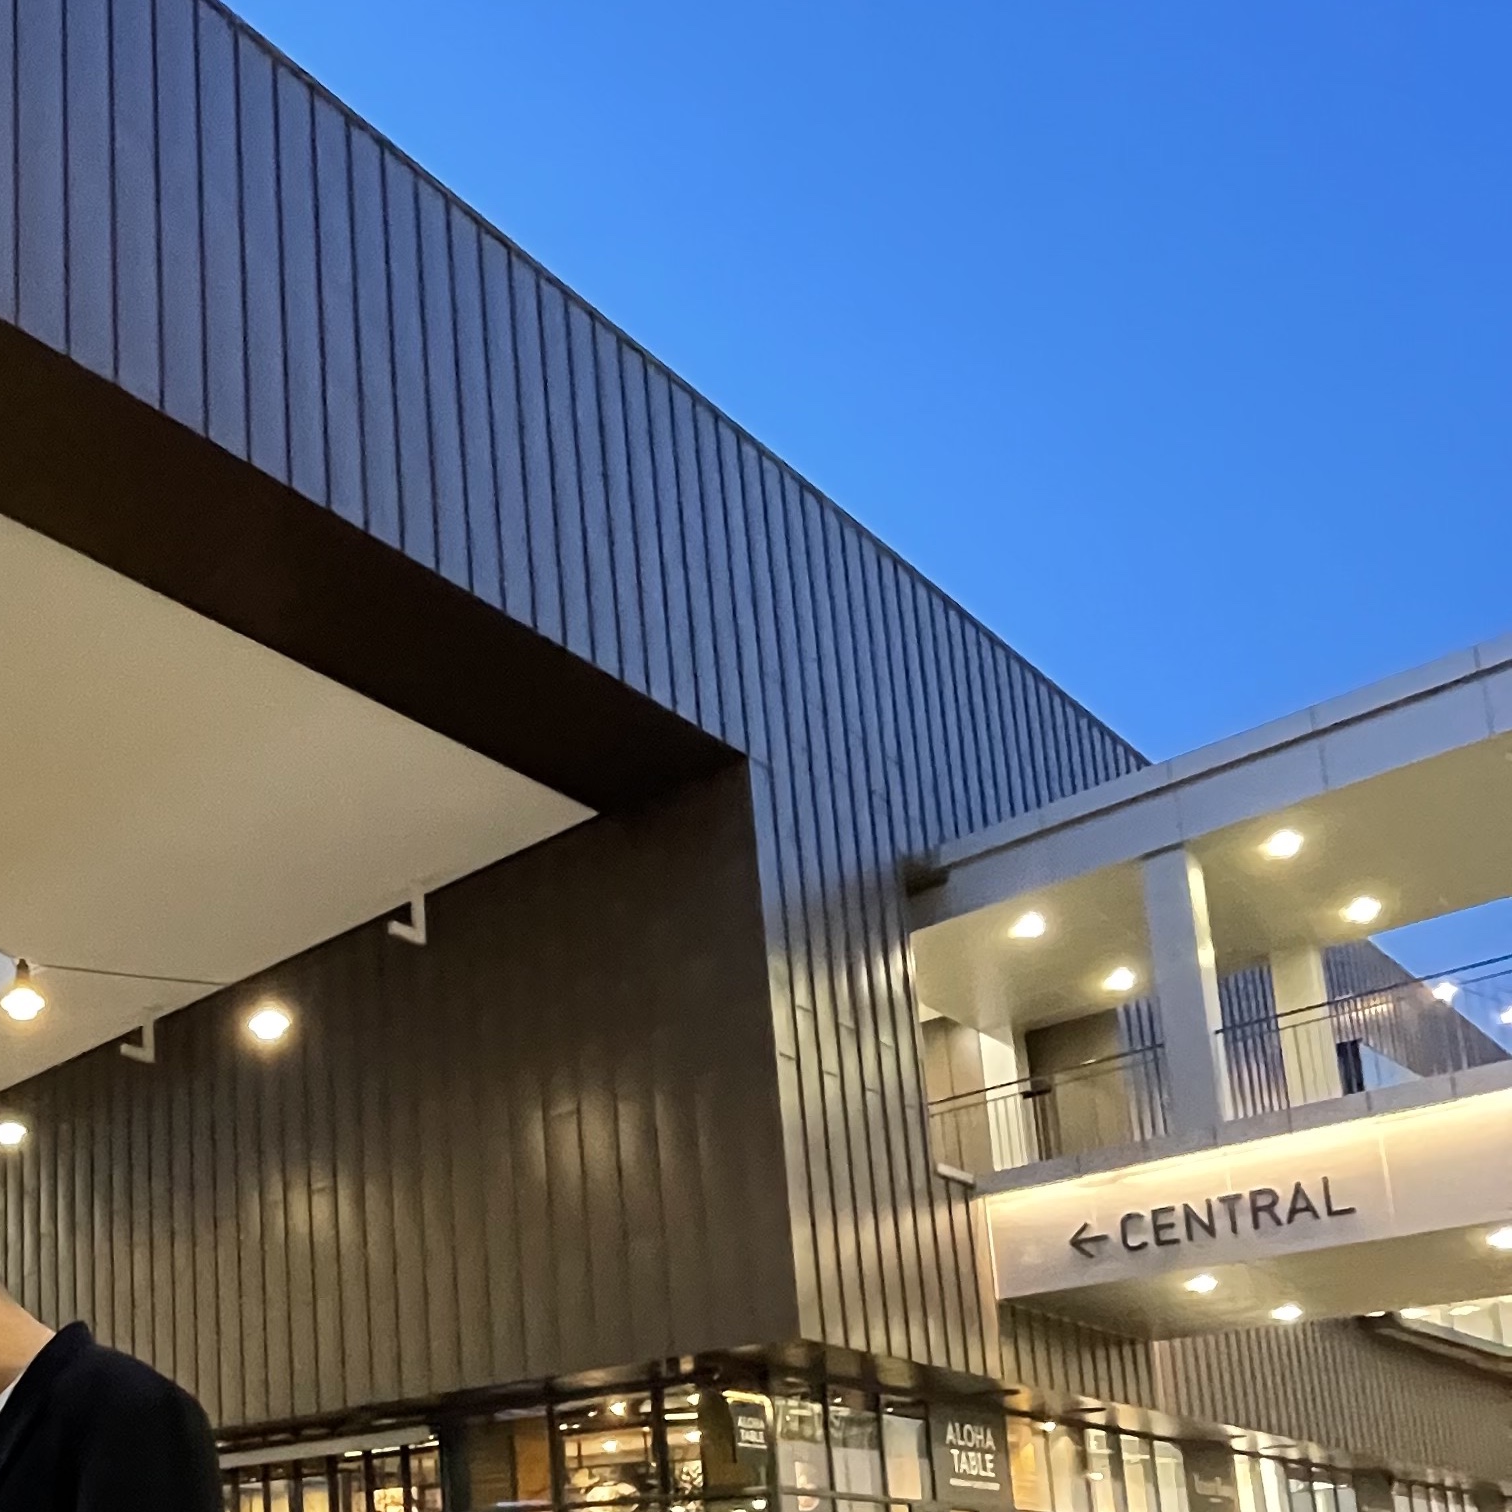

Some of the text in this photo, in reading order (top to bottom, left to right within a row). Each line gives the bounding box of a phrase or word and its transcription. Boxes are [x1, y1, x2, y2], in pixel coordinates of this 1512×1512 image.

[1119, 1175, 1357, 1252] CENTRAL
[945, 1420, 996, 1451] ALOHA
[950, 1448, 996, 1478] TABLE
